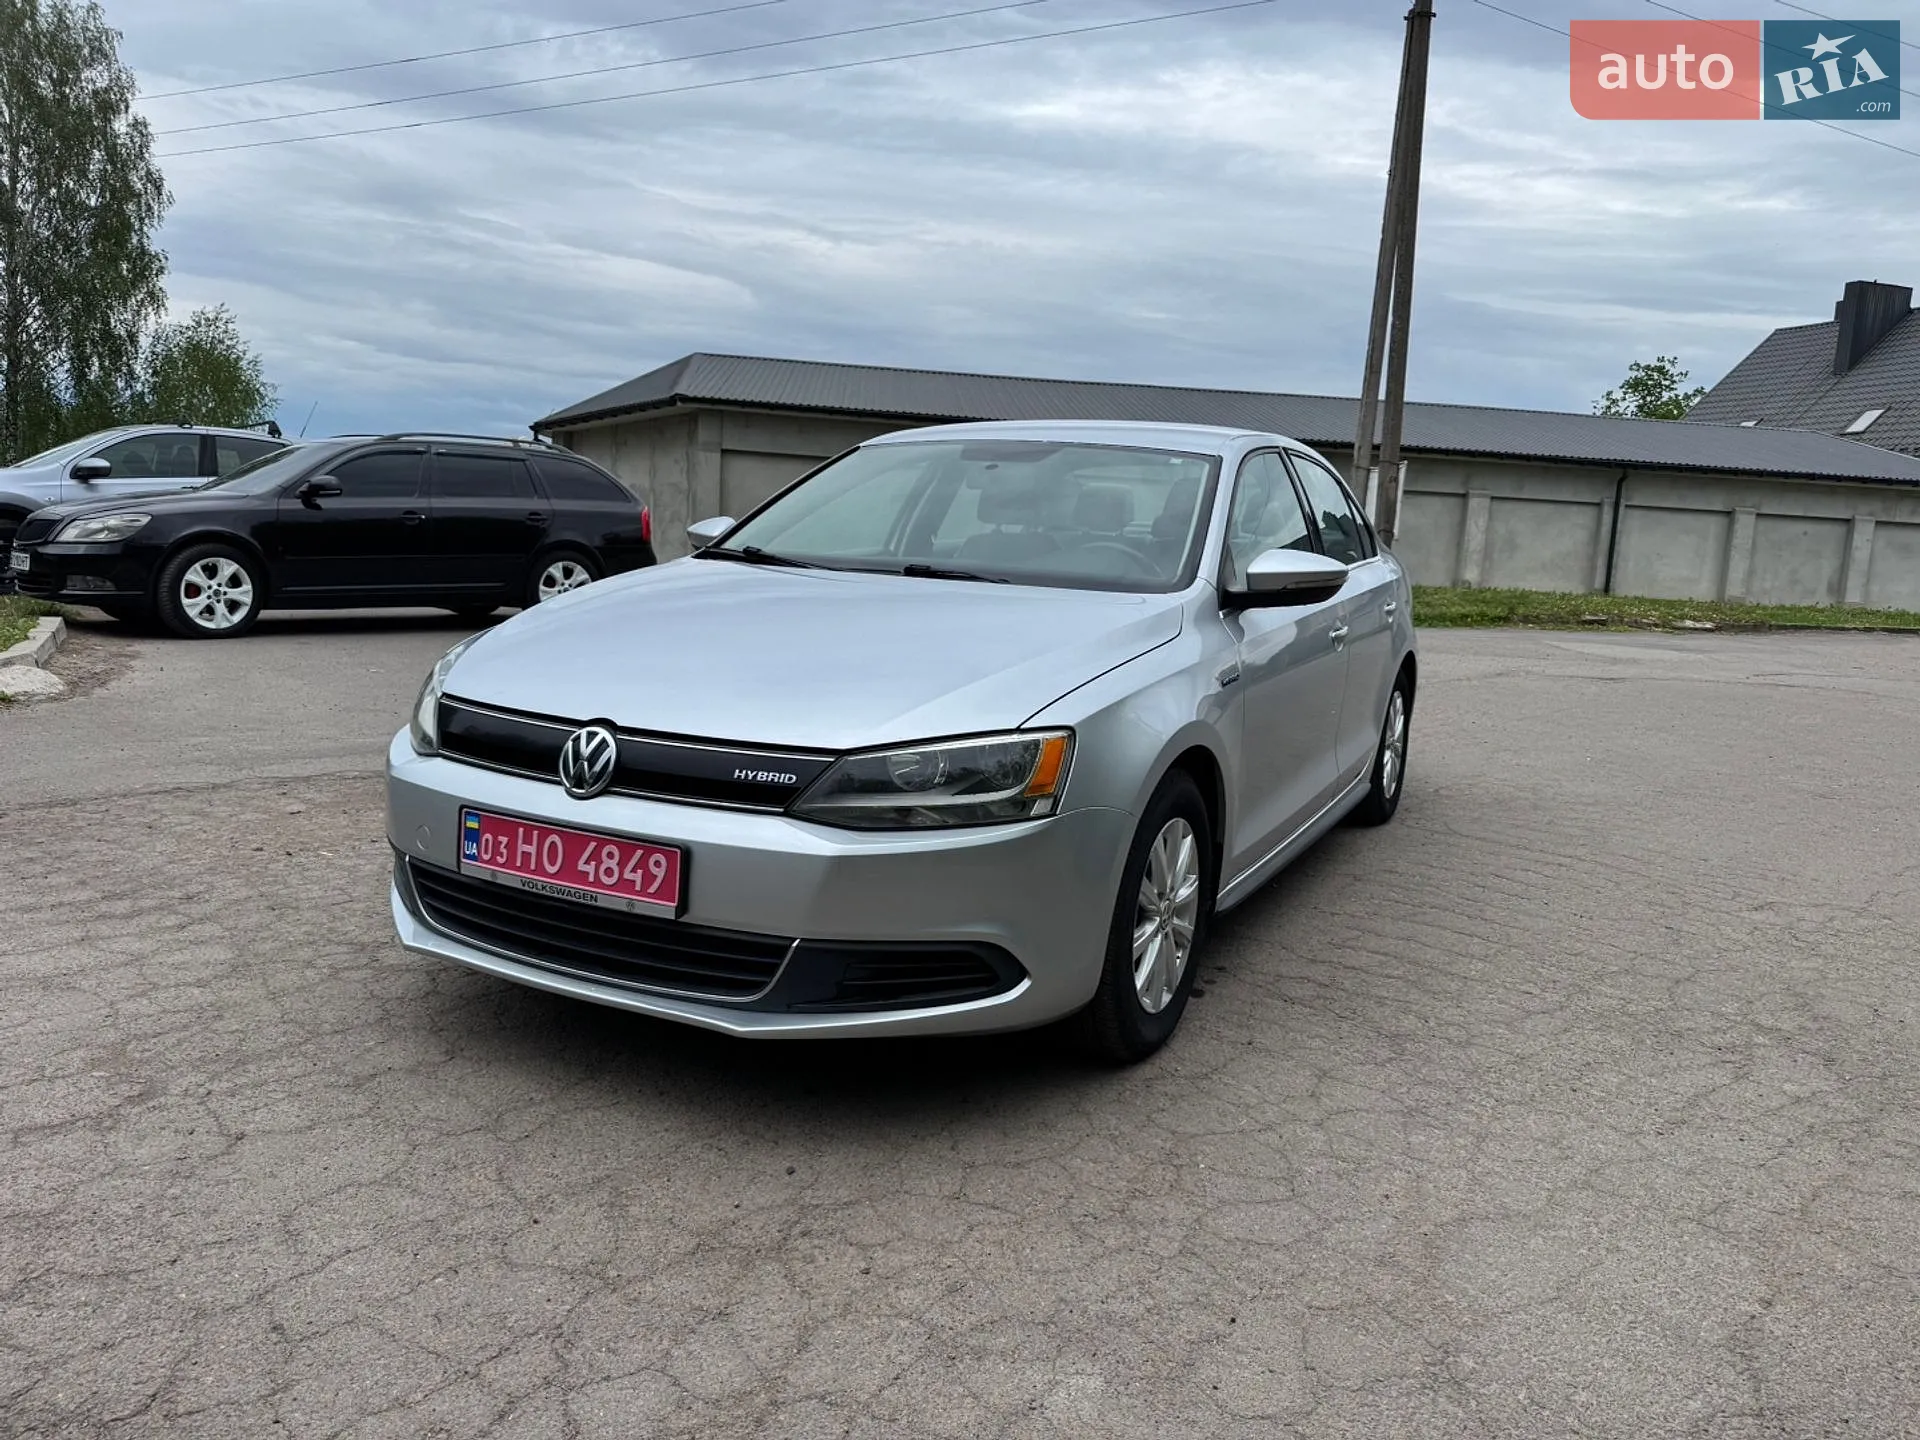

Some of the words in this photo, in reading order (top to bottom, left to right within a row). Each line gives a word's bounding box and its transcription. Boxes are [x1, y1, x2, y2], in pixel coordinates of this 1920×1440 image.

[733, 768, 798, 785] HYBRID
[464, 840, 479, 856] UA
[481, 833, 510, 864] 03
[577, 841, 668, 894] 4849
[519, 878, 599, 904] VOLKSWAGEN
